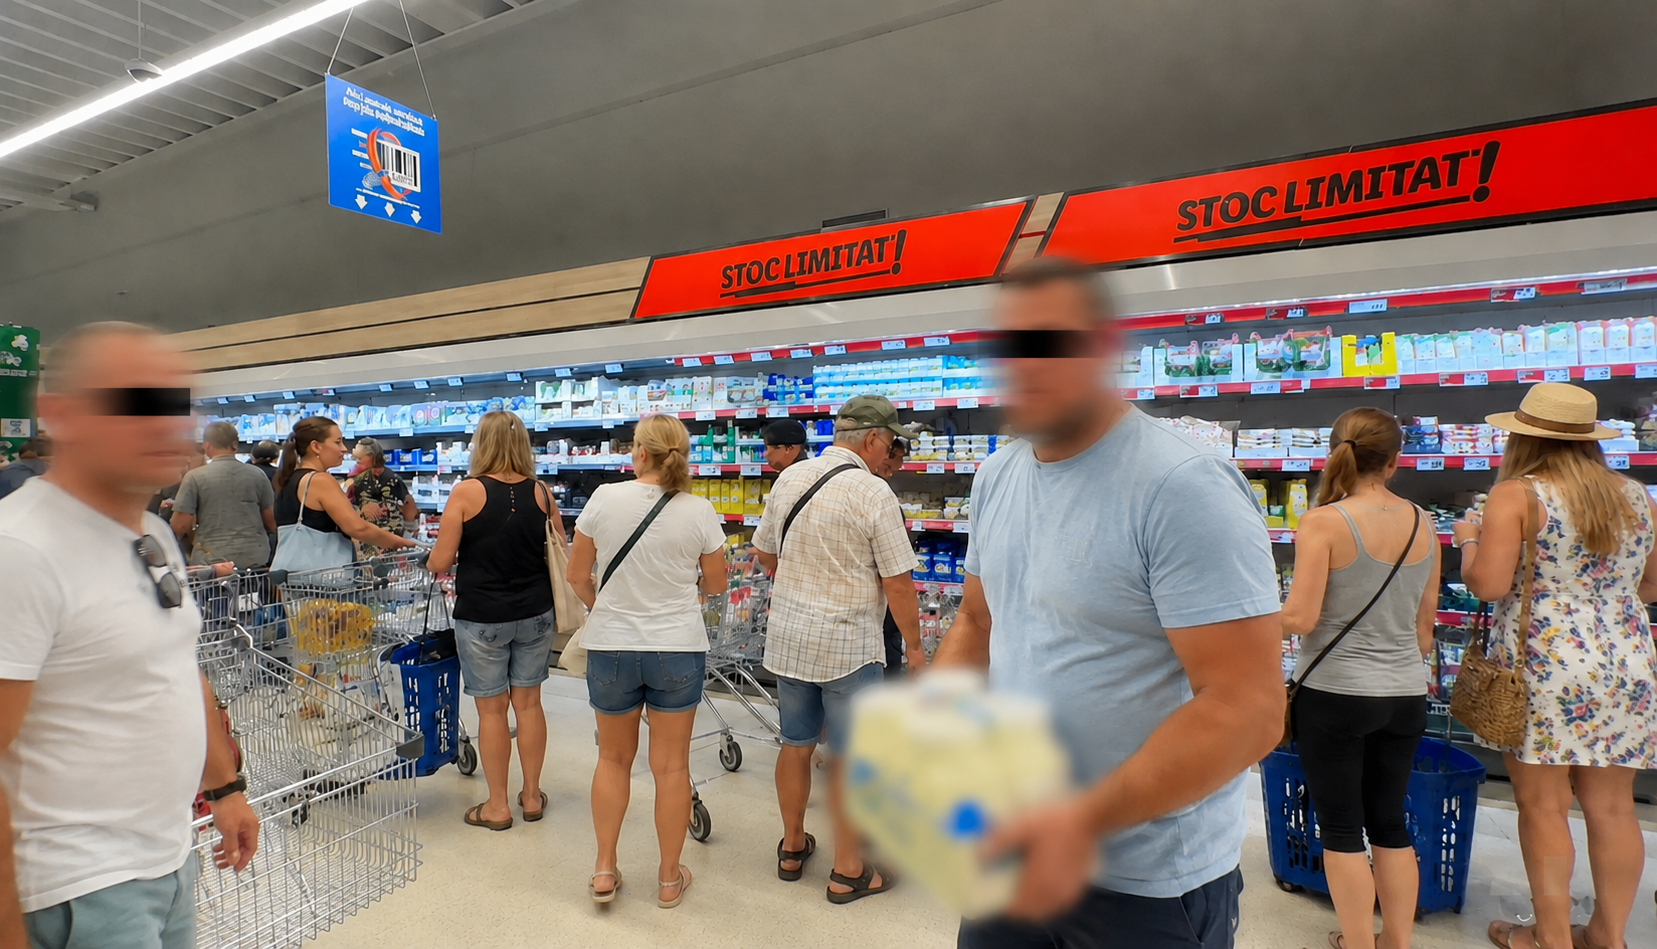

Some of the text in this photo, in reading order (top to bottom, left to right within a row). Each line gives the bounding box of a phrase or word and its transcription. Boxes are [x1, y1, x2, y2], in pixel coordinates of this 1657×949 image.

[1177, 140, 1501, 231] STOC LIMITAT!
[721, 229, 907, 290] STOC LIMITAT!
